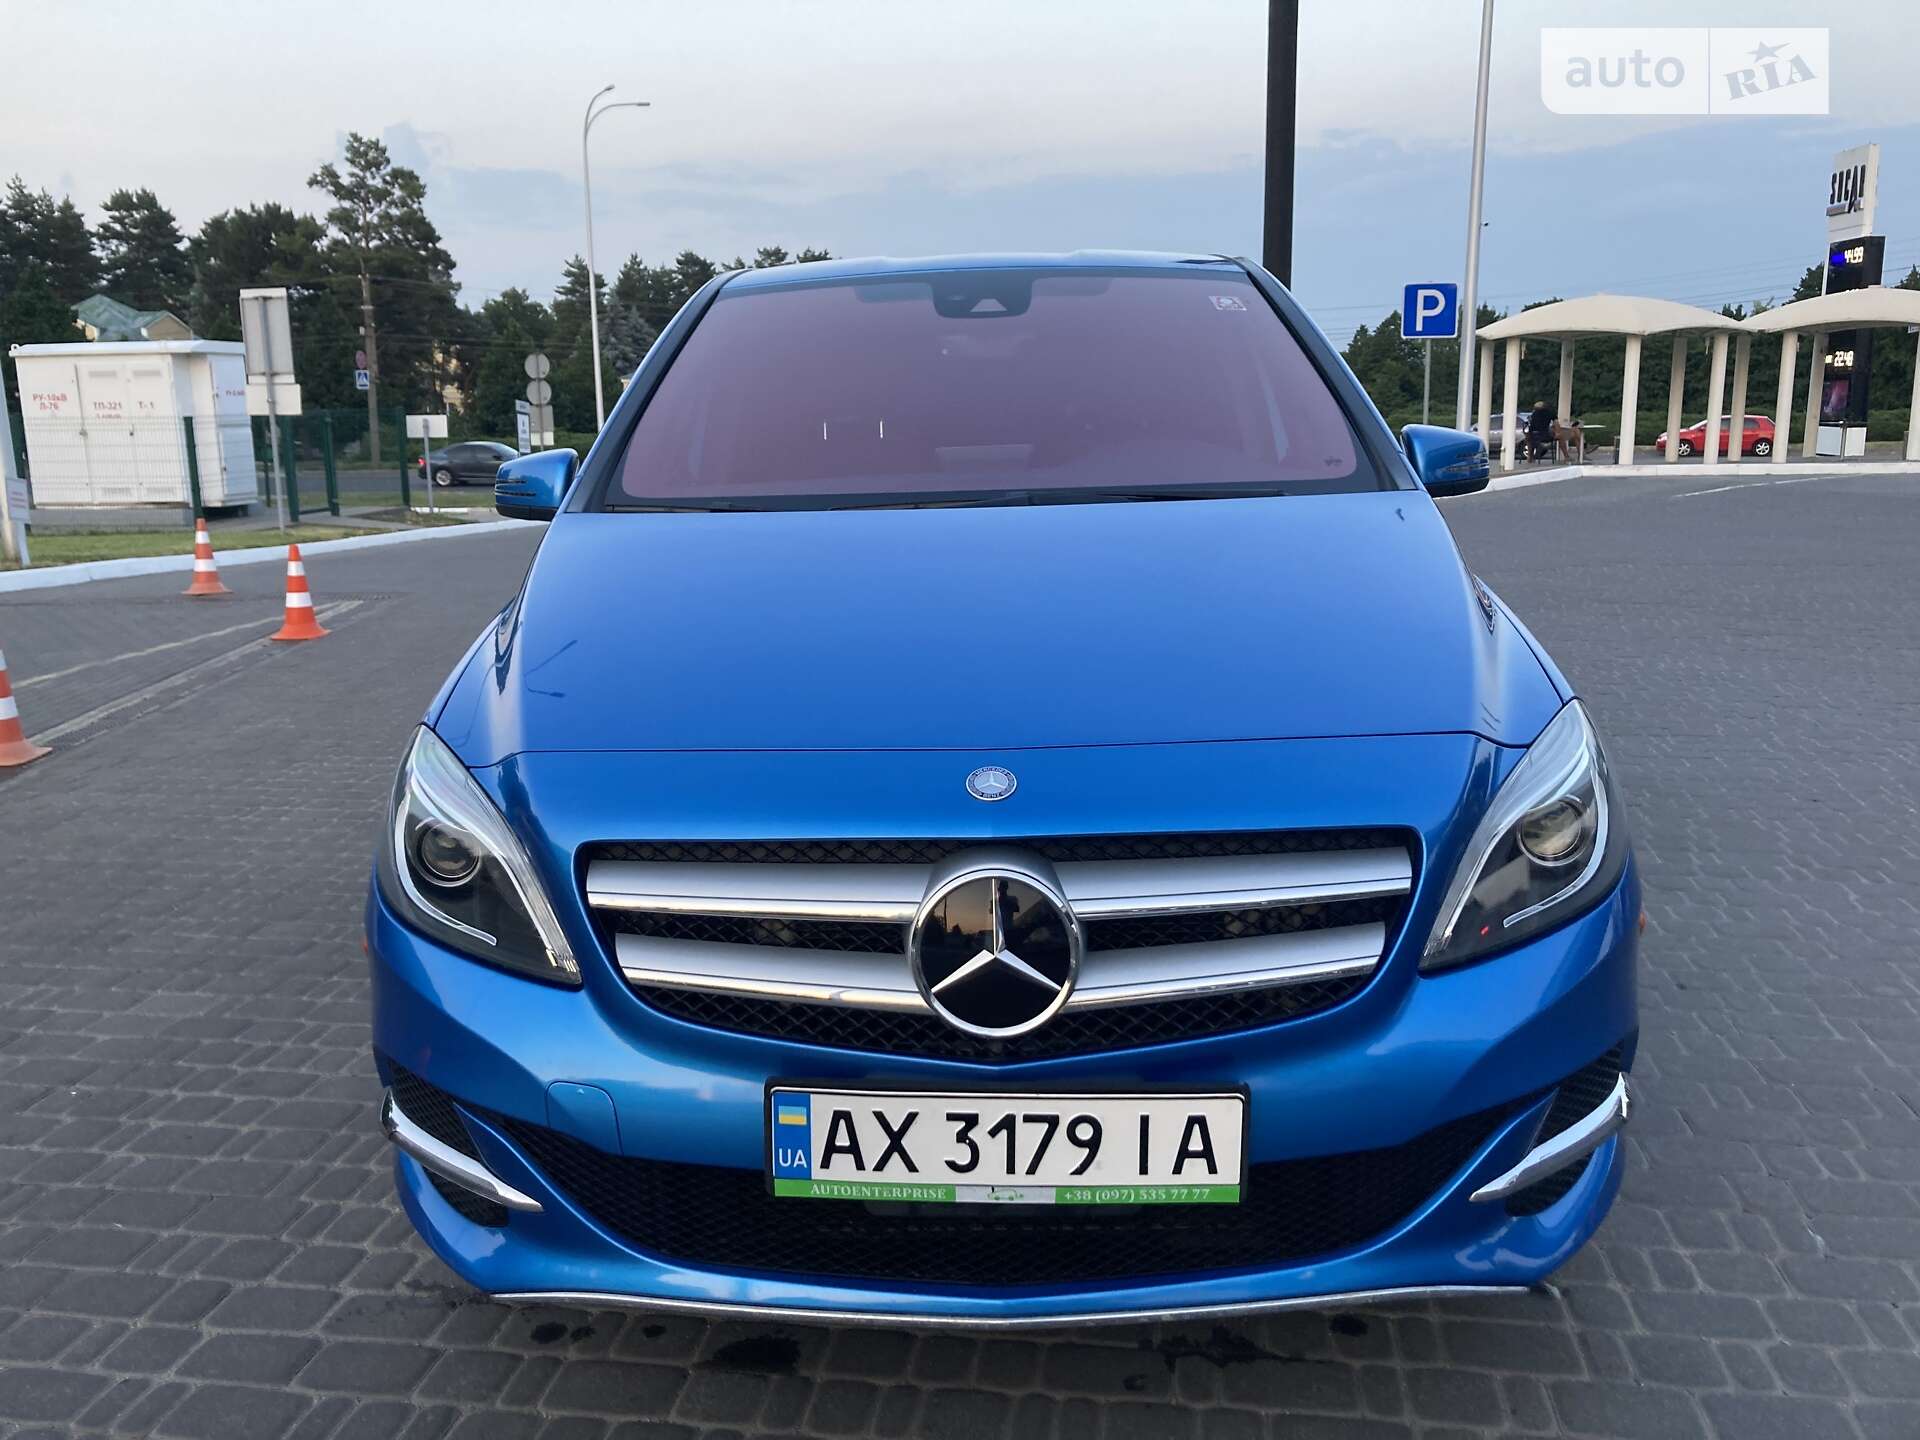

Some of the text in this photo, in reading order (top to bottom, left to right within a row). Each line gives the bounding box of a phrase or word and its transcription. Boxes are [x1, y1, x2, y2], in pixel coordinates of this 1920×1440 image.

[1415, 289, 1446, 332] P
[819, 1109, 920, 1173] AX
[943, 1112, 1104, 1176] 3179
[778, 1147, 808, 1168] UA
[810, 1183, 947, 1200] AUTOENTERPRISE
[1064, 1190, 1092, 1201] +38
[1095, 1188, 1136, 1203] (097)
[1139, 1188, 1167, 1201] 535
